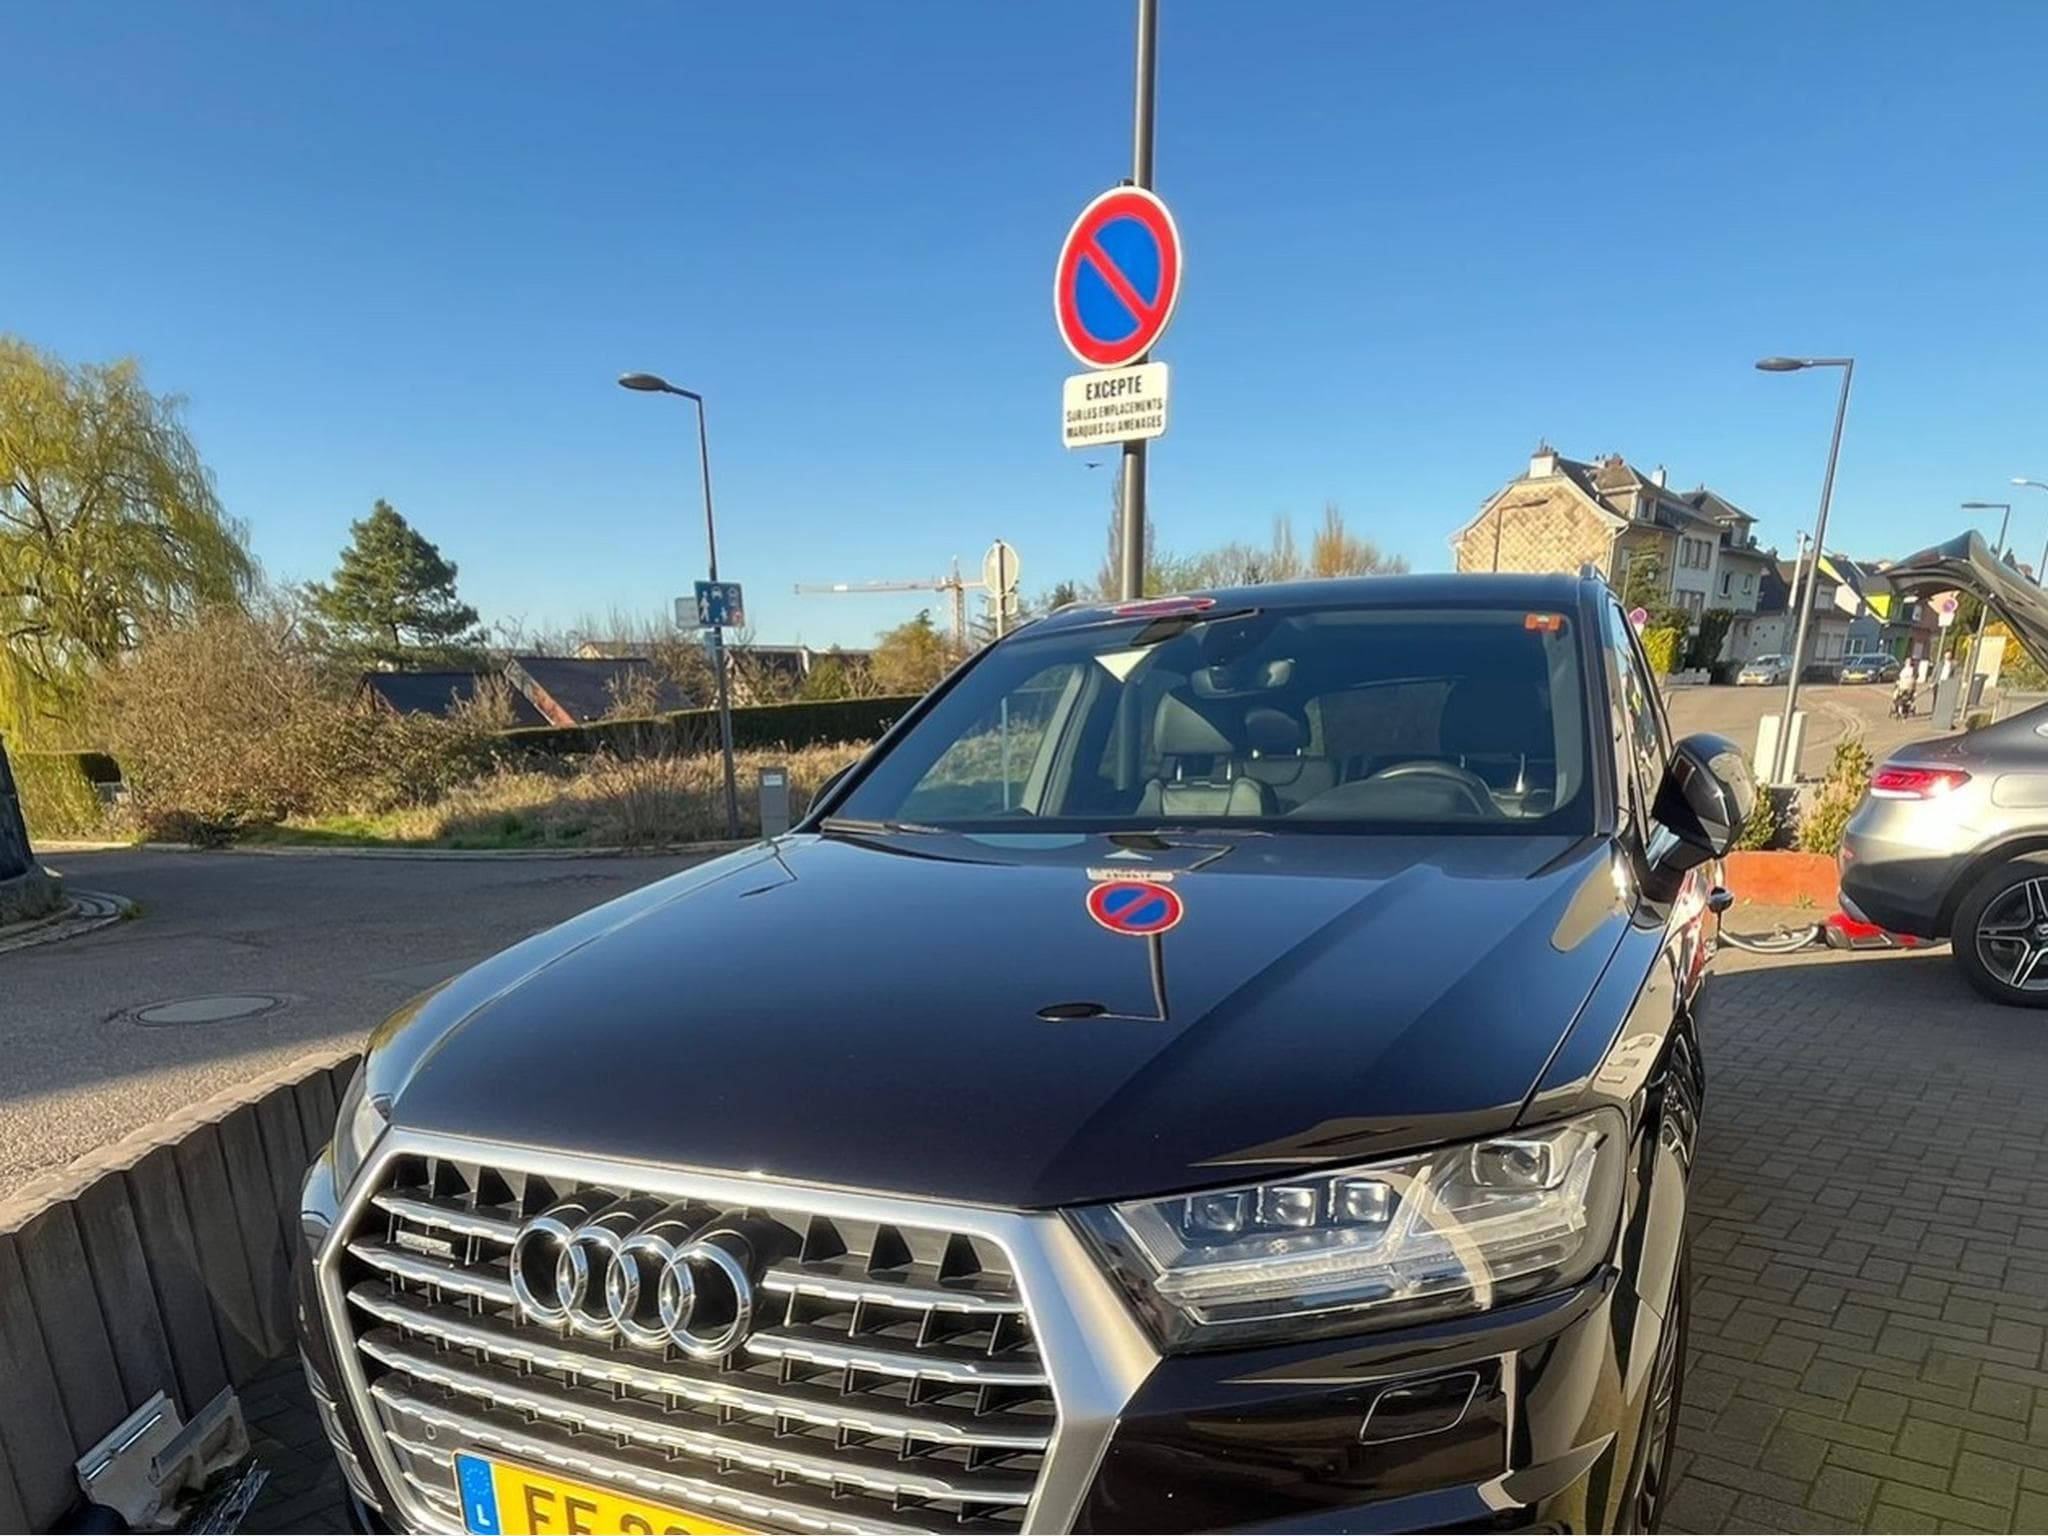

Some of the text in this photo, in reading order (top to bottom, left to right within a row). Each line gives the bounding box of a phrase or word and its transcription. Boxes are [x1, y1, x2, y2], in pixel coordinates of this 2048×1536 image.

[1086, 375, 1142, 401] EXCEPTE
[1066, 398, 1163, 423] SUR LES EMPLACEMENTS
[476, 1503, 491, 1527] L
